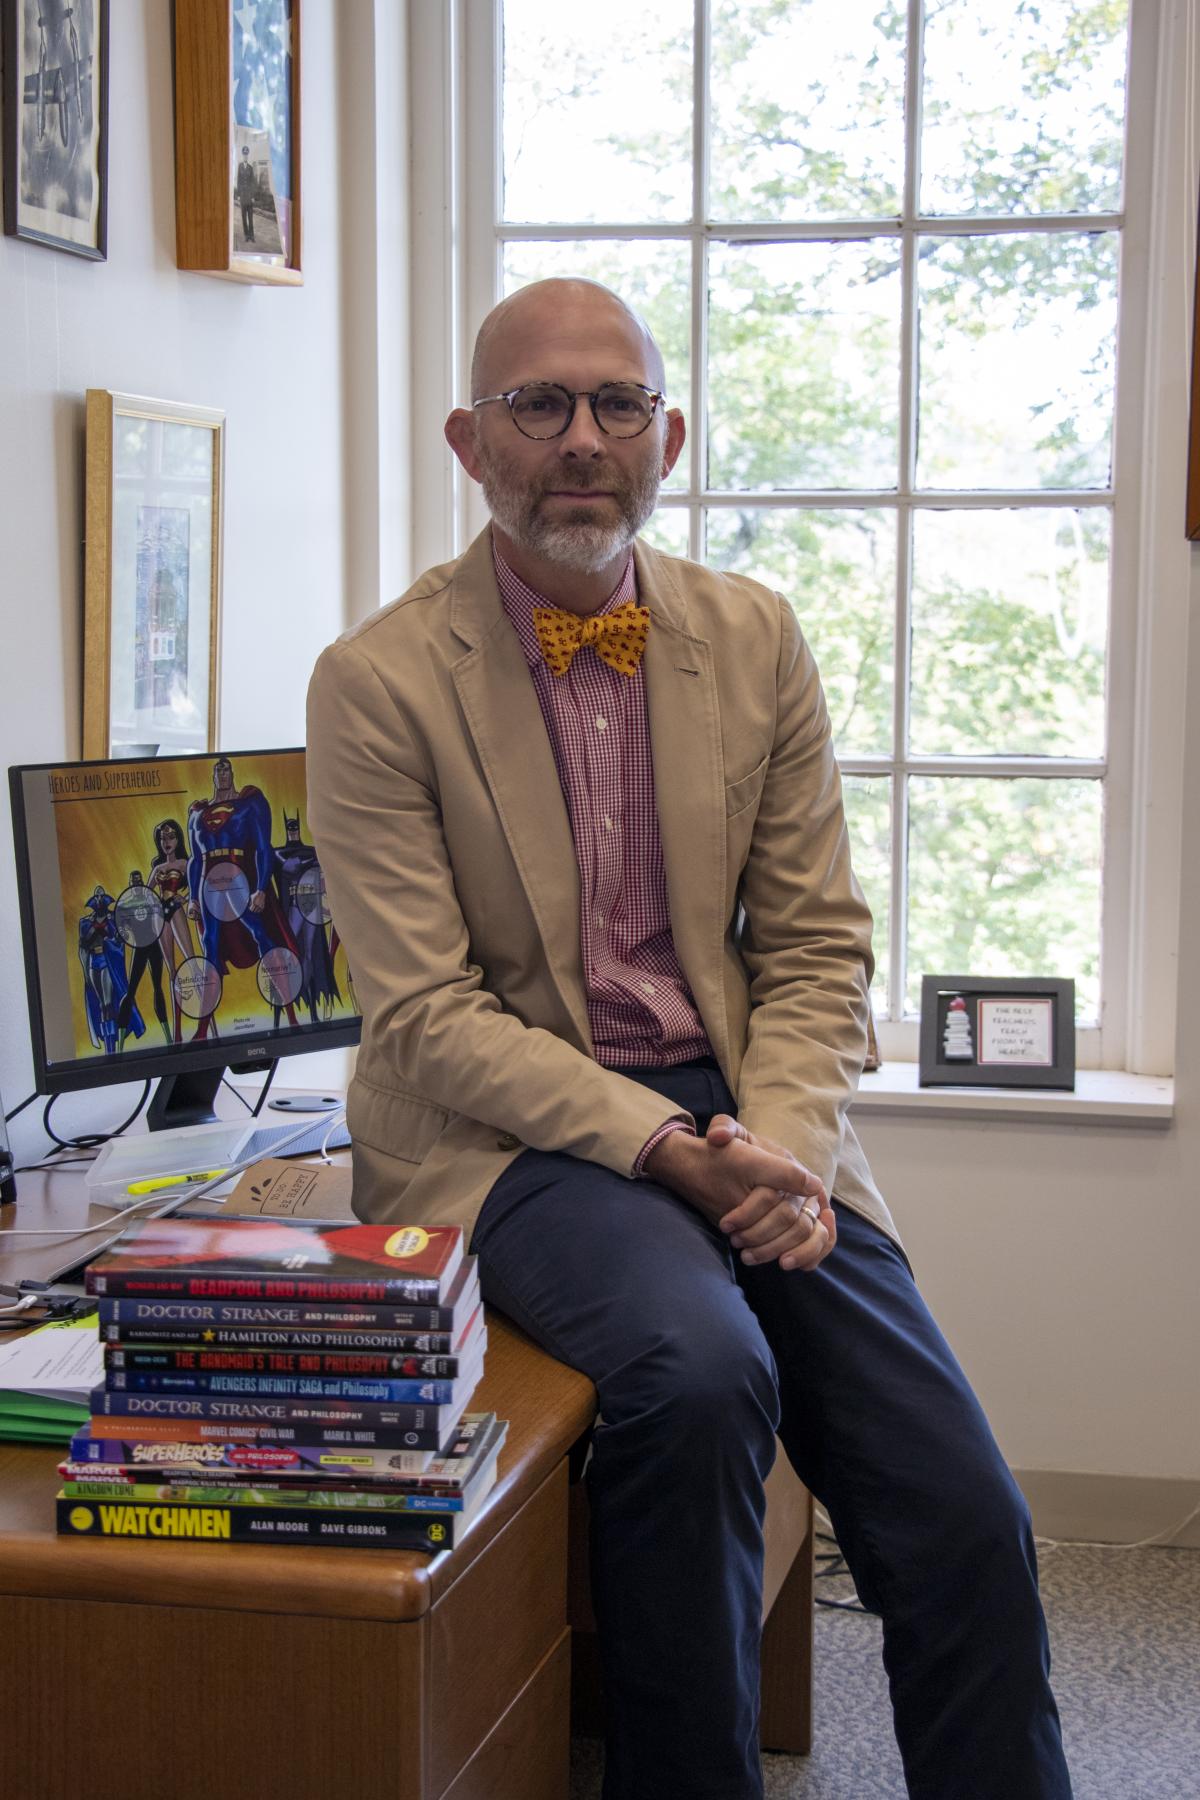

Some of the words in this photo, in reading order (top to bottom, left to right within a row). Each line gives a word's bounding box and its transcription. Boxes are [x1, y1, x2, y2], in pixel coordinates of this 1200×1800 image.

[48, 773, 81, 794] HEROES
[84, 771, 101, 791] AND
[189, 1279, 262, 1296] DEADPOOL
[265, 1281, 295, 1297] AND
[298, 1282, 386, 1300] PHILOSOPHY
[138, 1305, 215, 1319] DOCTOR
[222, 1307, 299, 1321] STRANGE
[305, 1312, 322, 1321] AND
[324, 1313, 377, 1322] PHILOSOPHY
[218, 1330, 288, 1343] HAMILTON
[292, 1334, 322, 1344] AND
[325, 1335, 407, 1347] PHILOSOPHY
[175, 1352, 195, 1367] THE
[269, 1355, 294, 1370] TALE
[299, 1356, 321, 1371] AND
[324, 1356, 389, 1373] PHILOSOPHY
[210, 1375, 257, 1392] AVENGERS
[259, 1377, 297, 1394] INFINITY
[299, 1379, 323, 1395] SAGA
[324, 1381, 341, 1395] and
[342, 1382, 389, 1399] Philosophy
[128, 1398, 204, 1414] DOCTOR
[210, 1402, 286, 1418] STRANGE
[292, 1409, 310, 1417] AND
[311, 1410, 363, 1420] PHILOSOPHY
[200, 1426, 228, 1437] MARVEL
[277, 1428, 295, 1439] WAR
[323, 1430, 345, 1440] MARK
[354, 1431, 376, 1442] WHITE
[132, 1443, 225, 1462] SUPERHEROES
[66, 1466, 122, 1475] MARVEL
[98, 1505, 231, 1539] WATCHMEN
[250, 1520, 274, 1531] ALAN
[276, 1521, 309, 1532] MOORE
[321, 1524, 345, 1535] DAVE
[347, 1525, 387, 1536] GIBBONS
